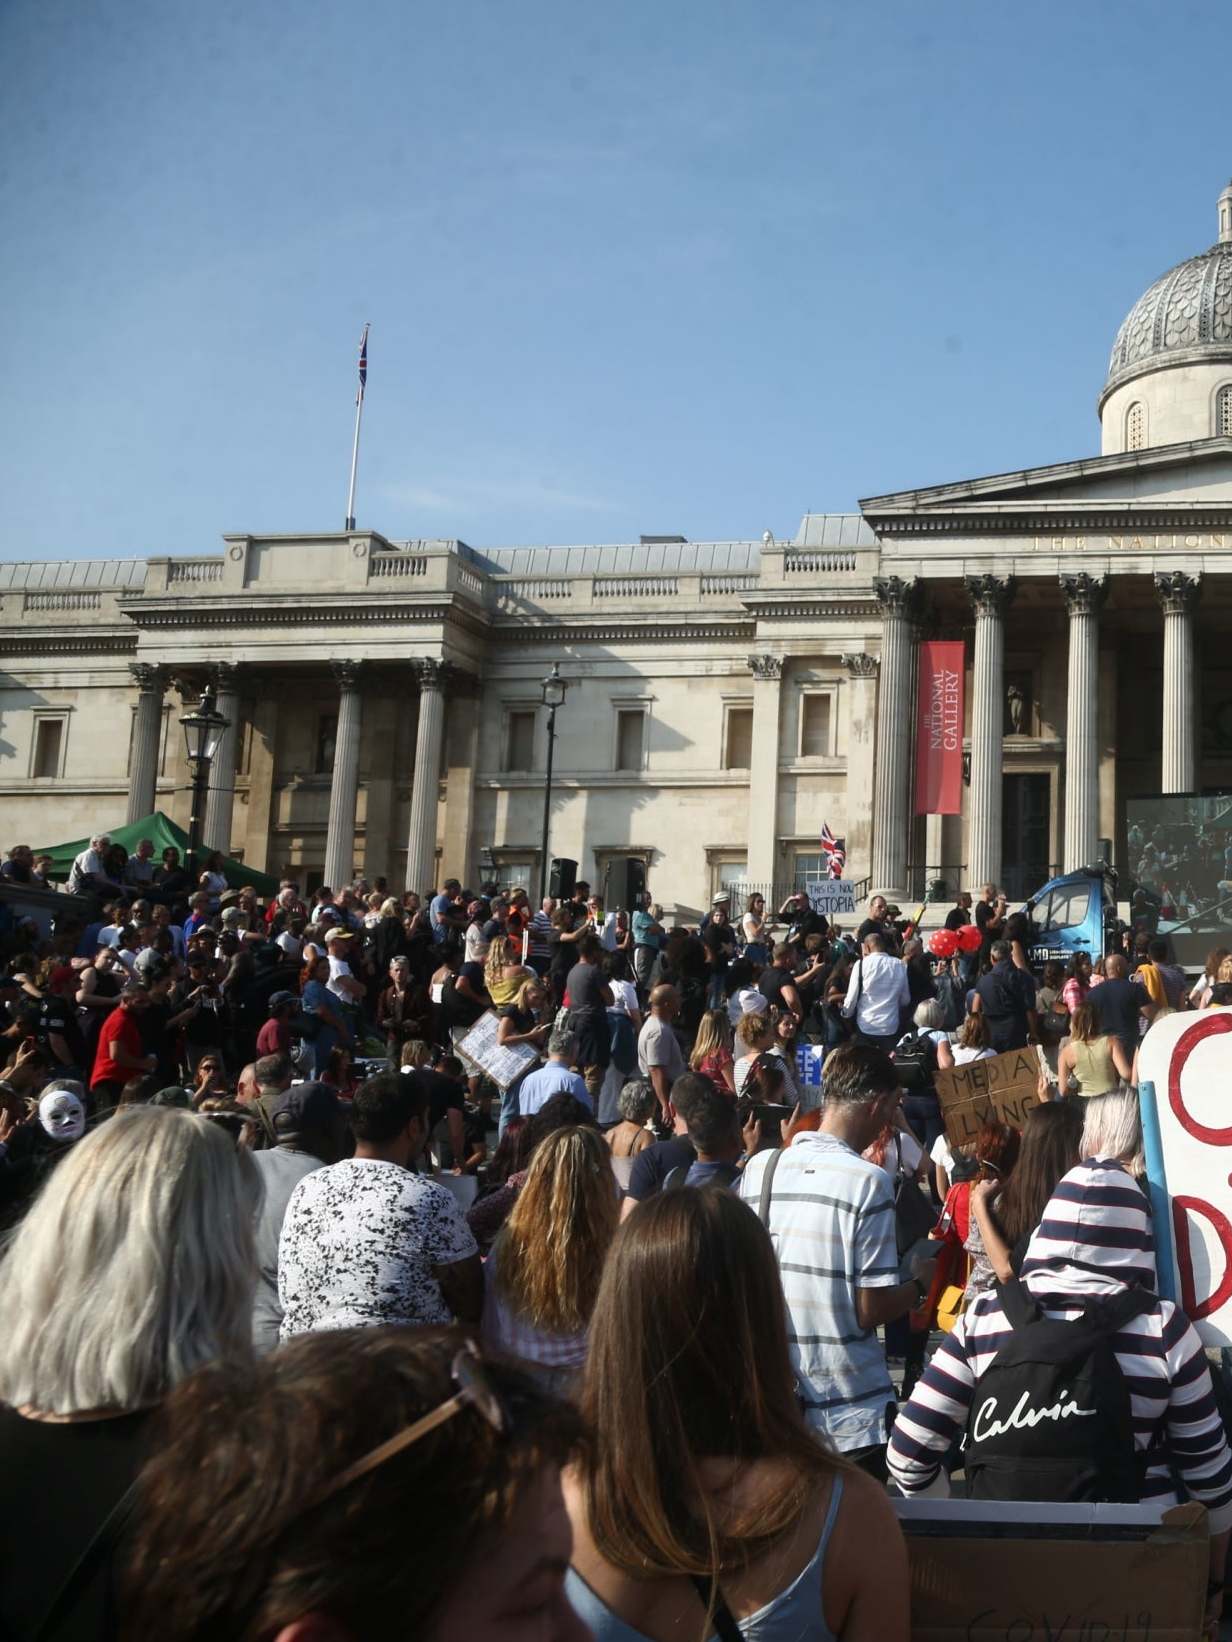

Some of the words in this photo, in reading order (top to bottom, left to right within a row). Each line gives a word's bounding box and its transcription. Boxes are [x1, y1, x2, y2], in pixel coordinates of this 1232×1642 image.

[1032, 535, 1086, 550] THE
[931, 670, 944, 750] NATIONAL
[944, 670, 958, 751] GALLERY
[951, 1054, 1034, 1095] MEDIA
[973, 1389, 1097, 1442] Calvin
